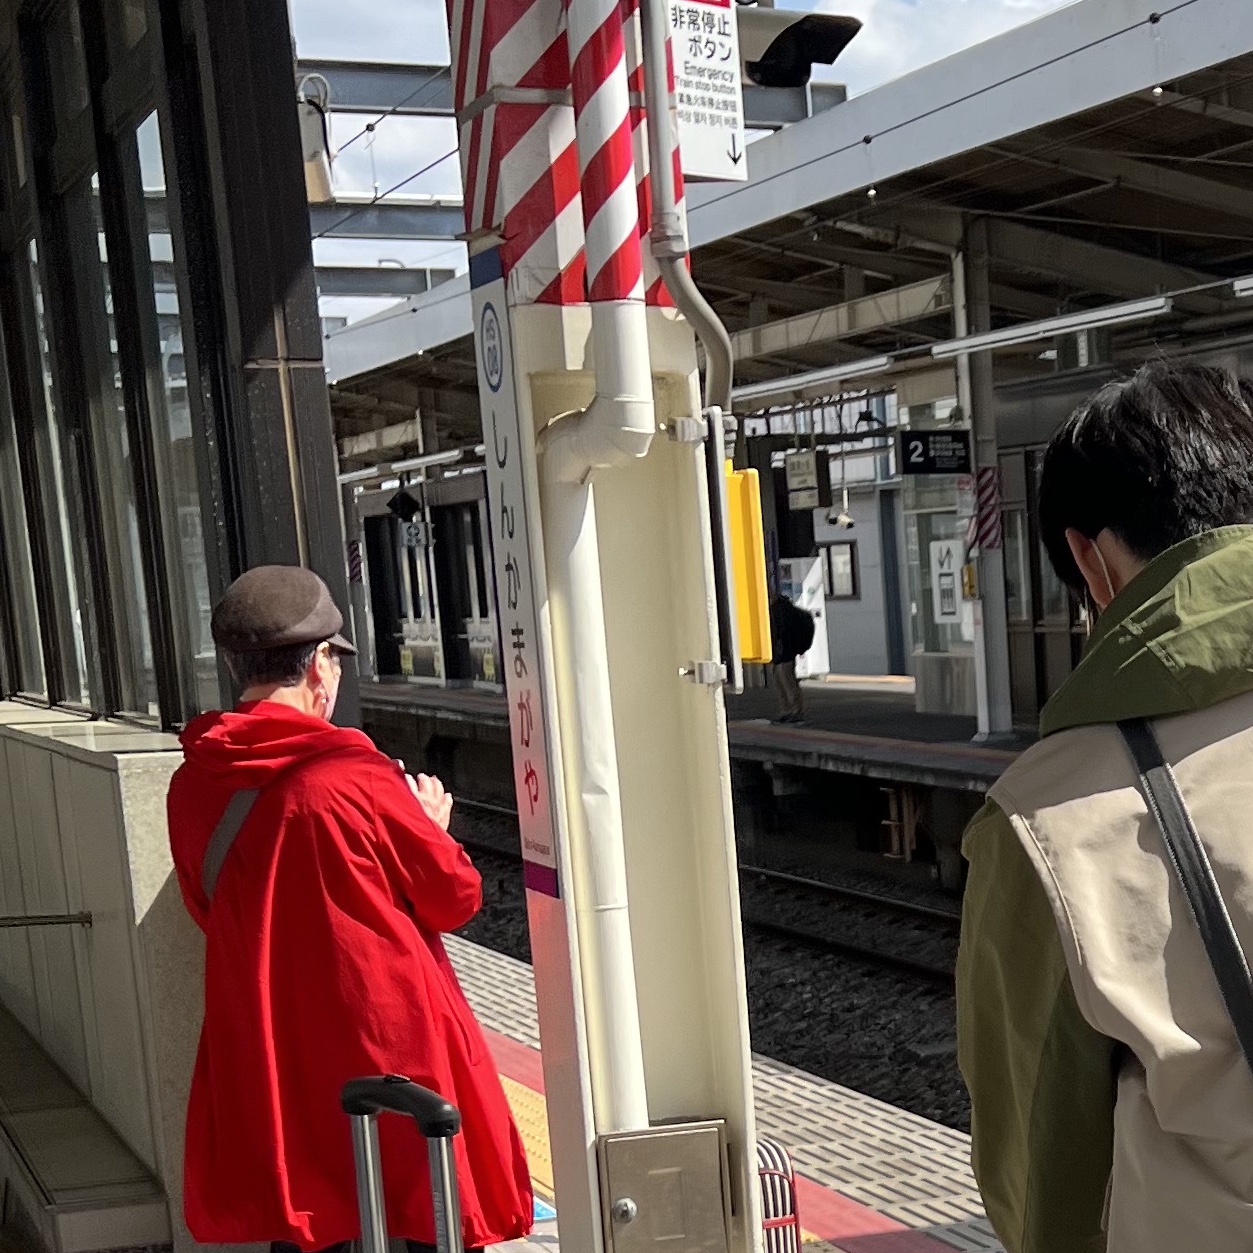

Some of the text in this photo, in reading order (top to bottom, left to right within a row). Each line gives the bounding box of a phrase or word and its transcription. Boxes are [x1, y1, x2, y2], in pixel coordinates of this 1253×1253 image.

[671, 5, 732, 37] 非常停止
[688, 35, 732, 61] ボタン
[684, 61, 735, 83] Emergency
[908, 440, 925, 463] 2
